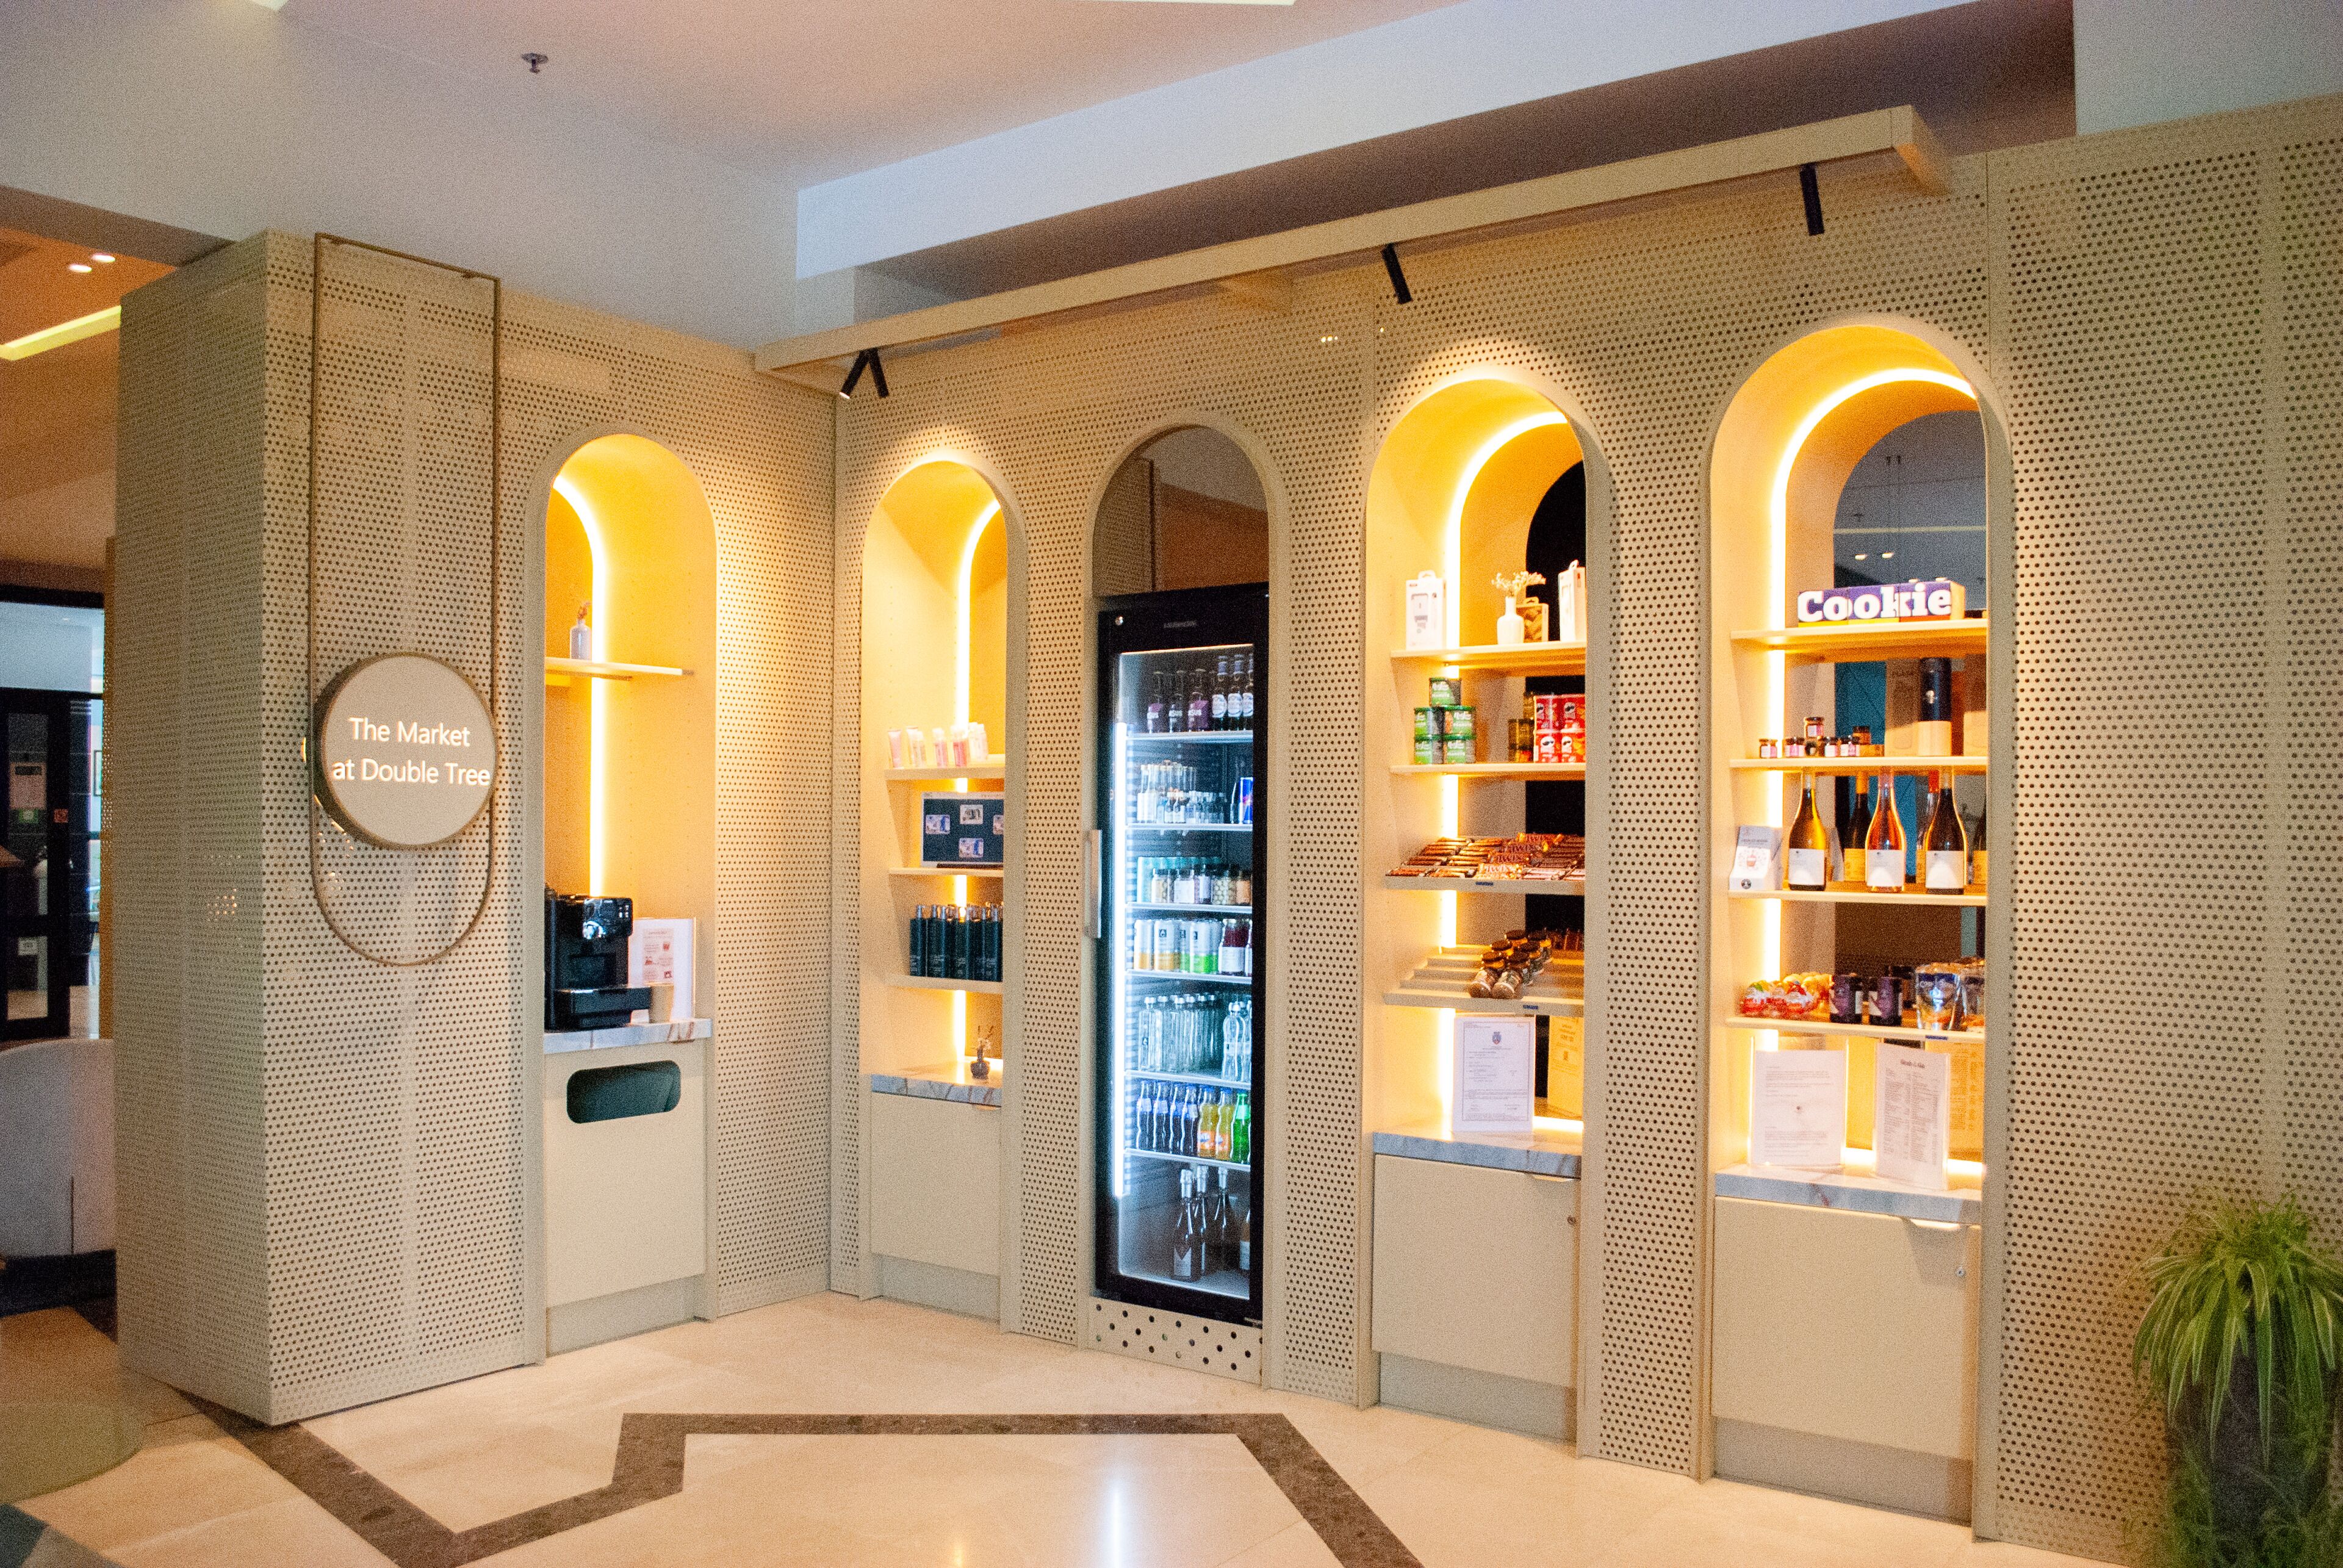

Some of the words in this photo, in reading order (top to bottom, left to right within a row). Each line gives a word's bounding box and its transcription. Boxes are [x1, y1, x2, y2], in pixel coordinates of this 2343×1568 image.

[1798, 583, 1951, 622] Cookie
[348, 717, 390, 741] The
[397, 721, 470, 747] Market
[333, 760, 355, 780] at
[361, 758, 439, 783] Double
[444, 763, 491, 785] Tree
